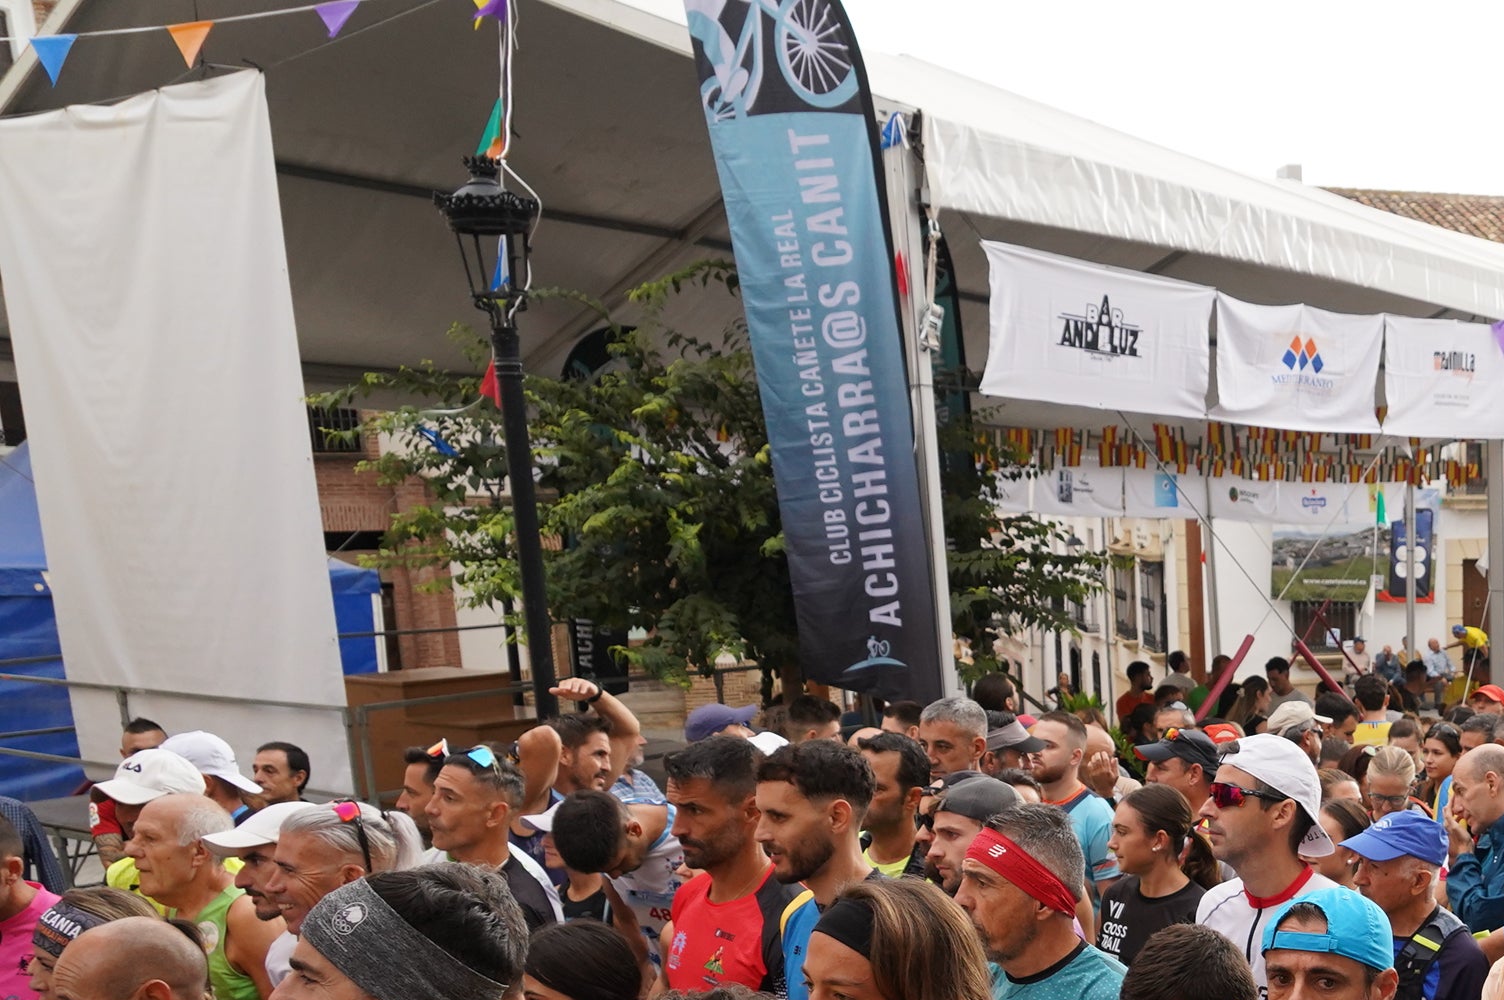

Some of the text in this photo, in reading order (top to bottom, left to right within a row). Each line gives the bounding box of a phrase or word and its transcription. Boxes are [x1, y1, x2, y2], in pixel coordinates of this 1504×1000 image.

[771, 209, 852, 565] CLUB CICLISTA CAÑETE LA REAL
[788, 128, 902, 627] ACHICHARRA@S CANIT
[1086, 294, 1124, 327] BAR
